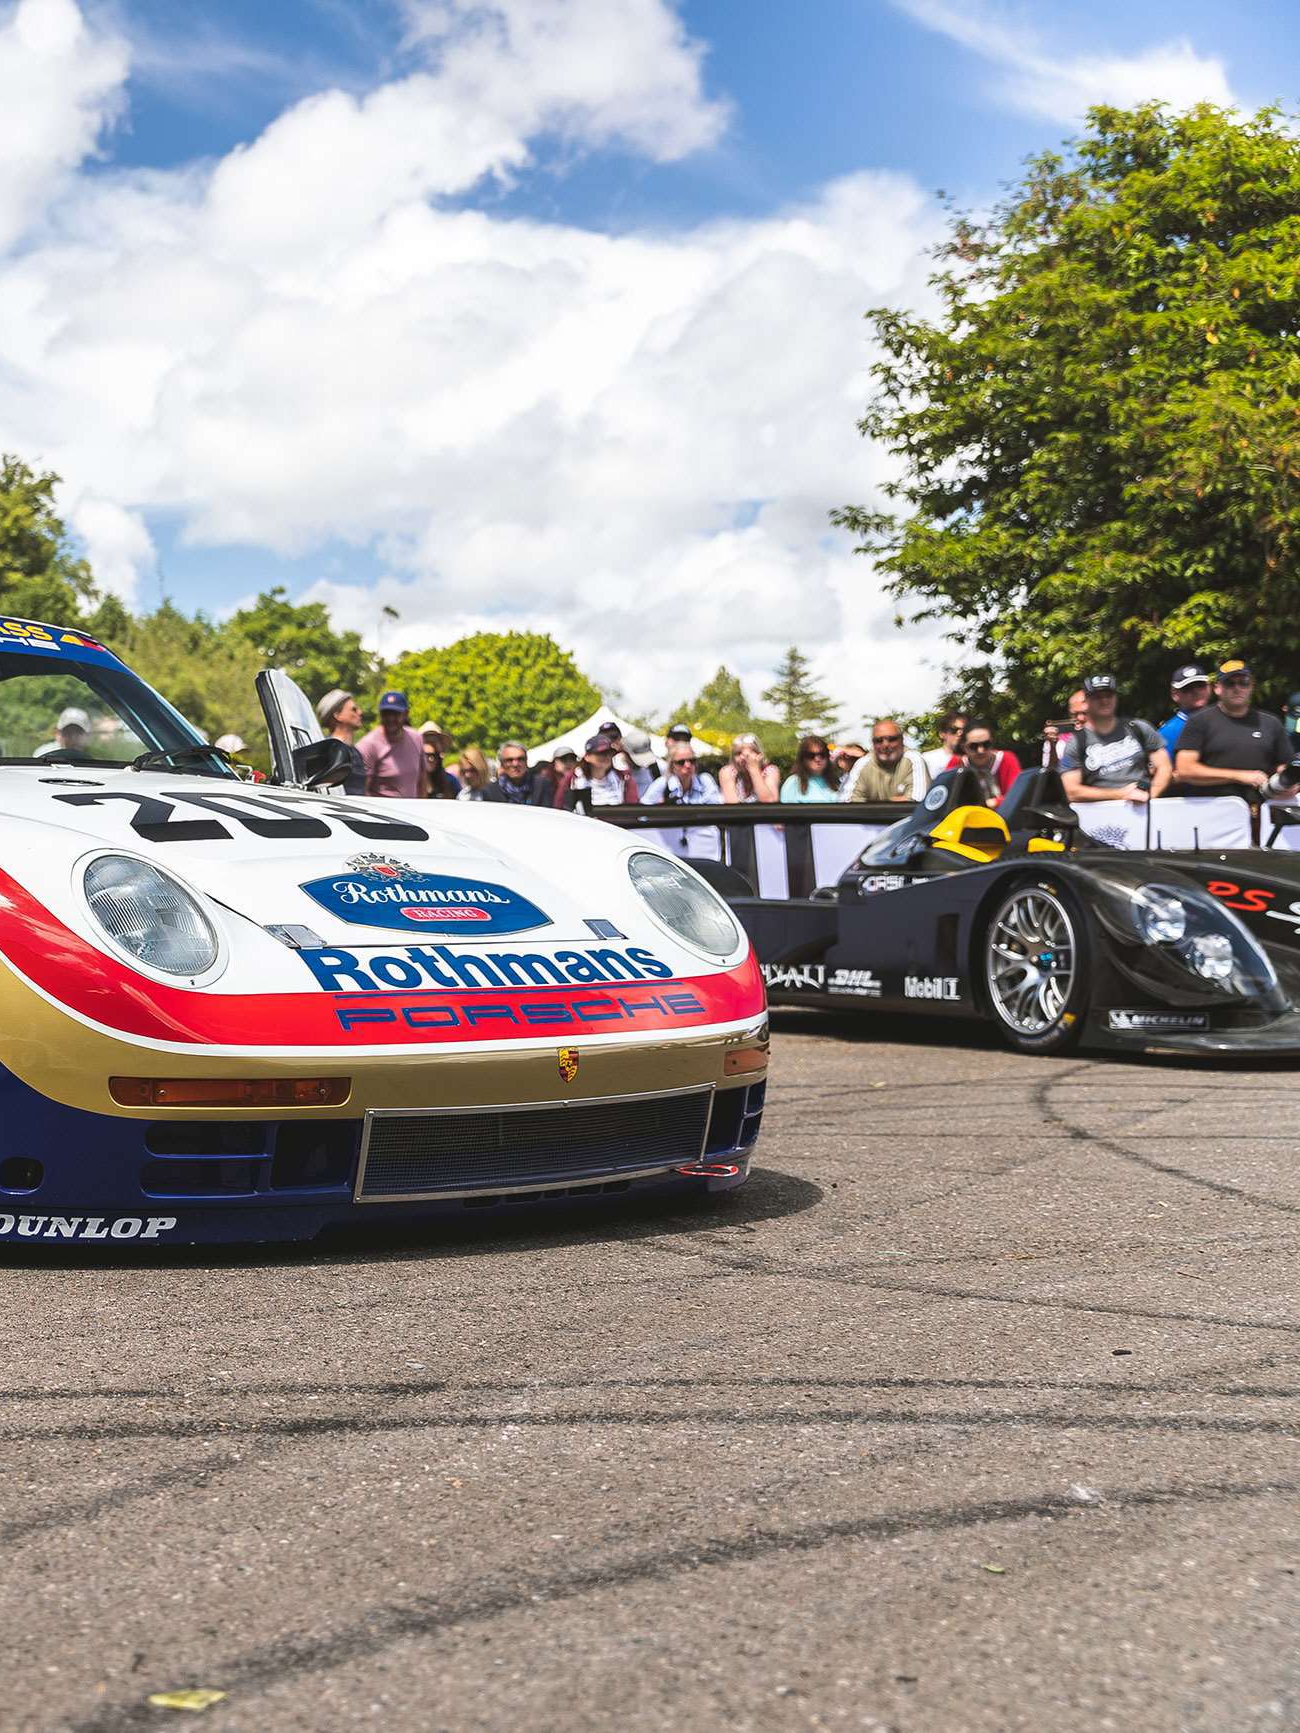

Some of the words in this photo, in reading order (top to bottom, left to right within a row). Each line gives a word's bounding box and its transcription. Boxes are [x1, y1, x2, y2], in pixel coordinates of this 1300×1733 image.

[52, 792, 429, 843] 203
[333, 881, 510, 905] Rothmans
[412, 909, 479, 919] RACING
[295, 945, 674, 991] Rothmans
[333, 993, 706, 1032] PORSCHE
[1131, 1014, 1205, 1025] MICHELIN
